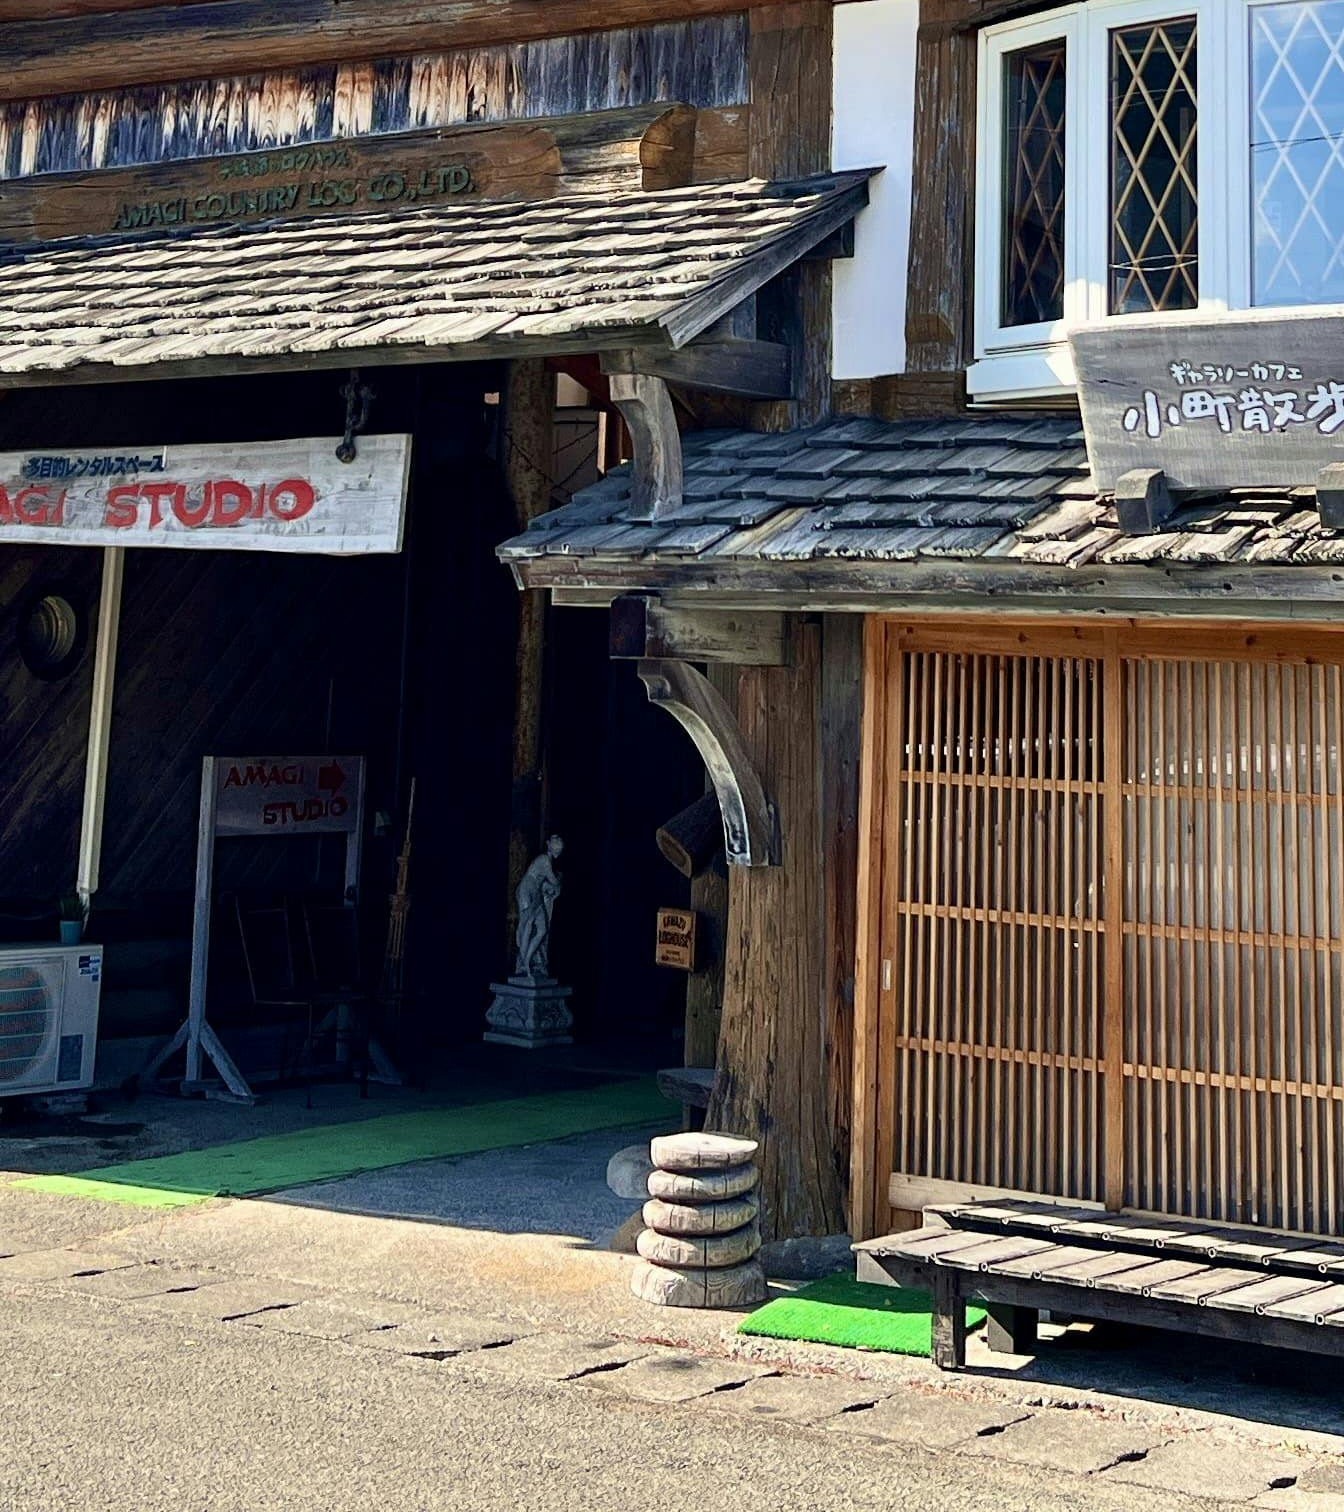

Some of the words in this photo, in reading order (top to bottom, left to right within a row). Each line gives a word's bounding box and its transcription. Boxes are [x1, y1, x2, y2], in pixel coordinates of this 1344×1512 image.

[193, 185, 298, 219] COUNTRY
[306, 178, 358, 205] LOG
[1168, 361, 1303, 385] ギャラリーカフェ
[24, 455, 165, 479] 多目的レンタルスペース
[104, 479, 316, 529] STUDIO
[224, 764, 305, 789] AMAGI
[262, 795, 349, 825] STUDIO
